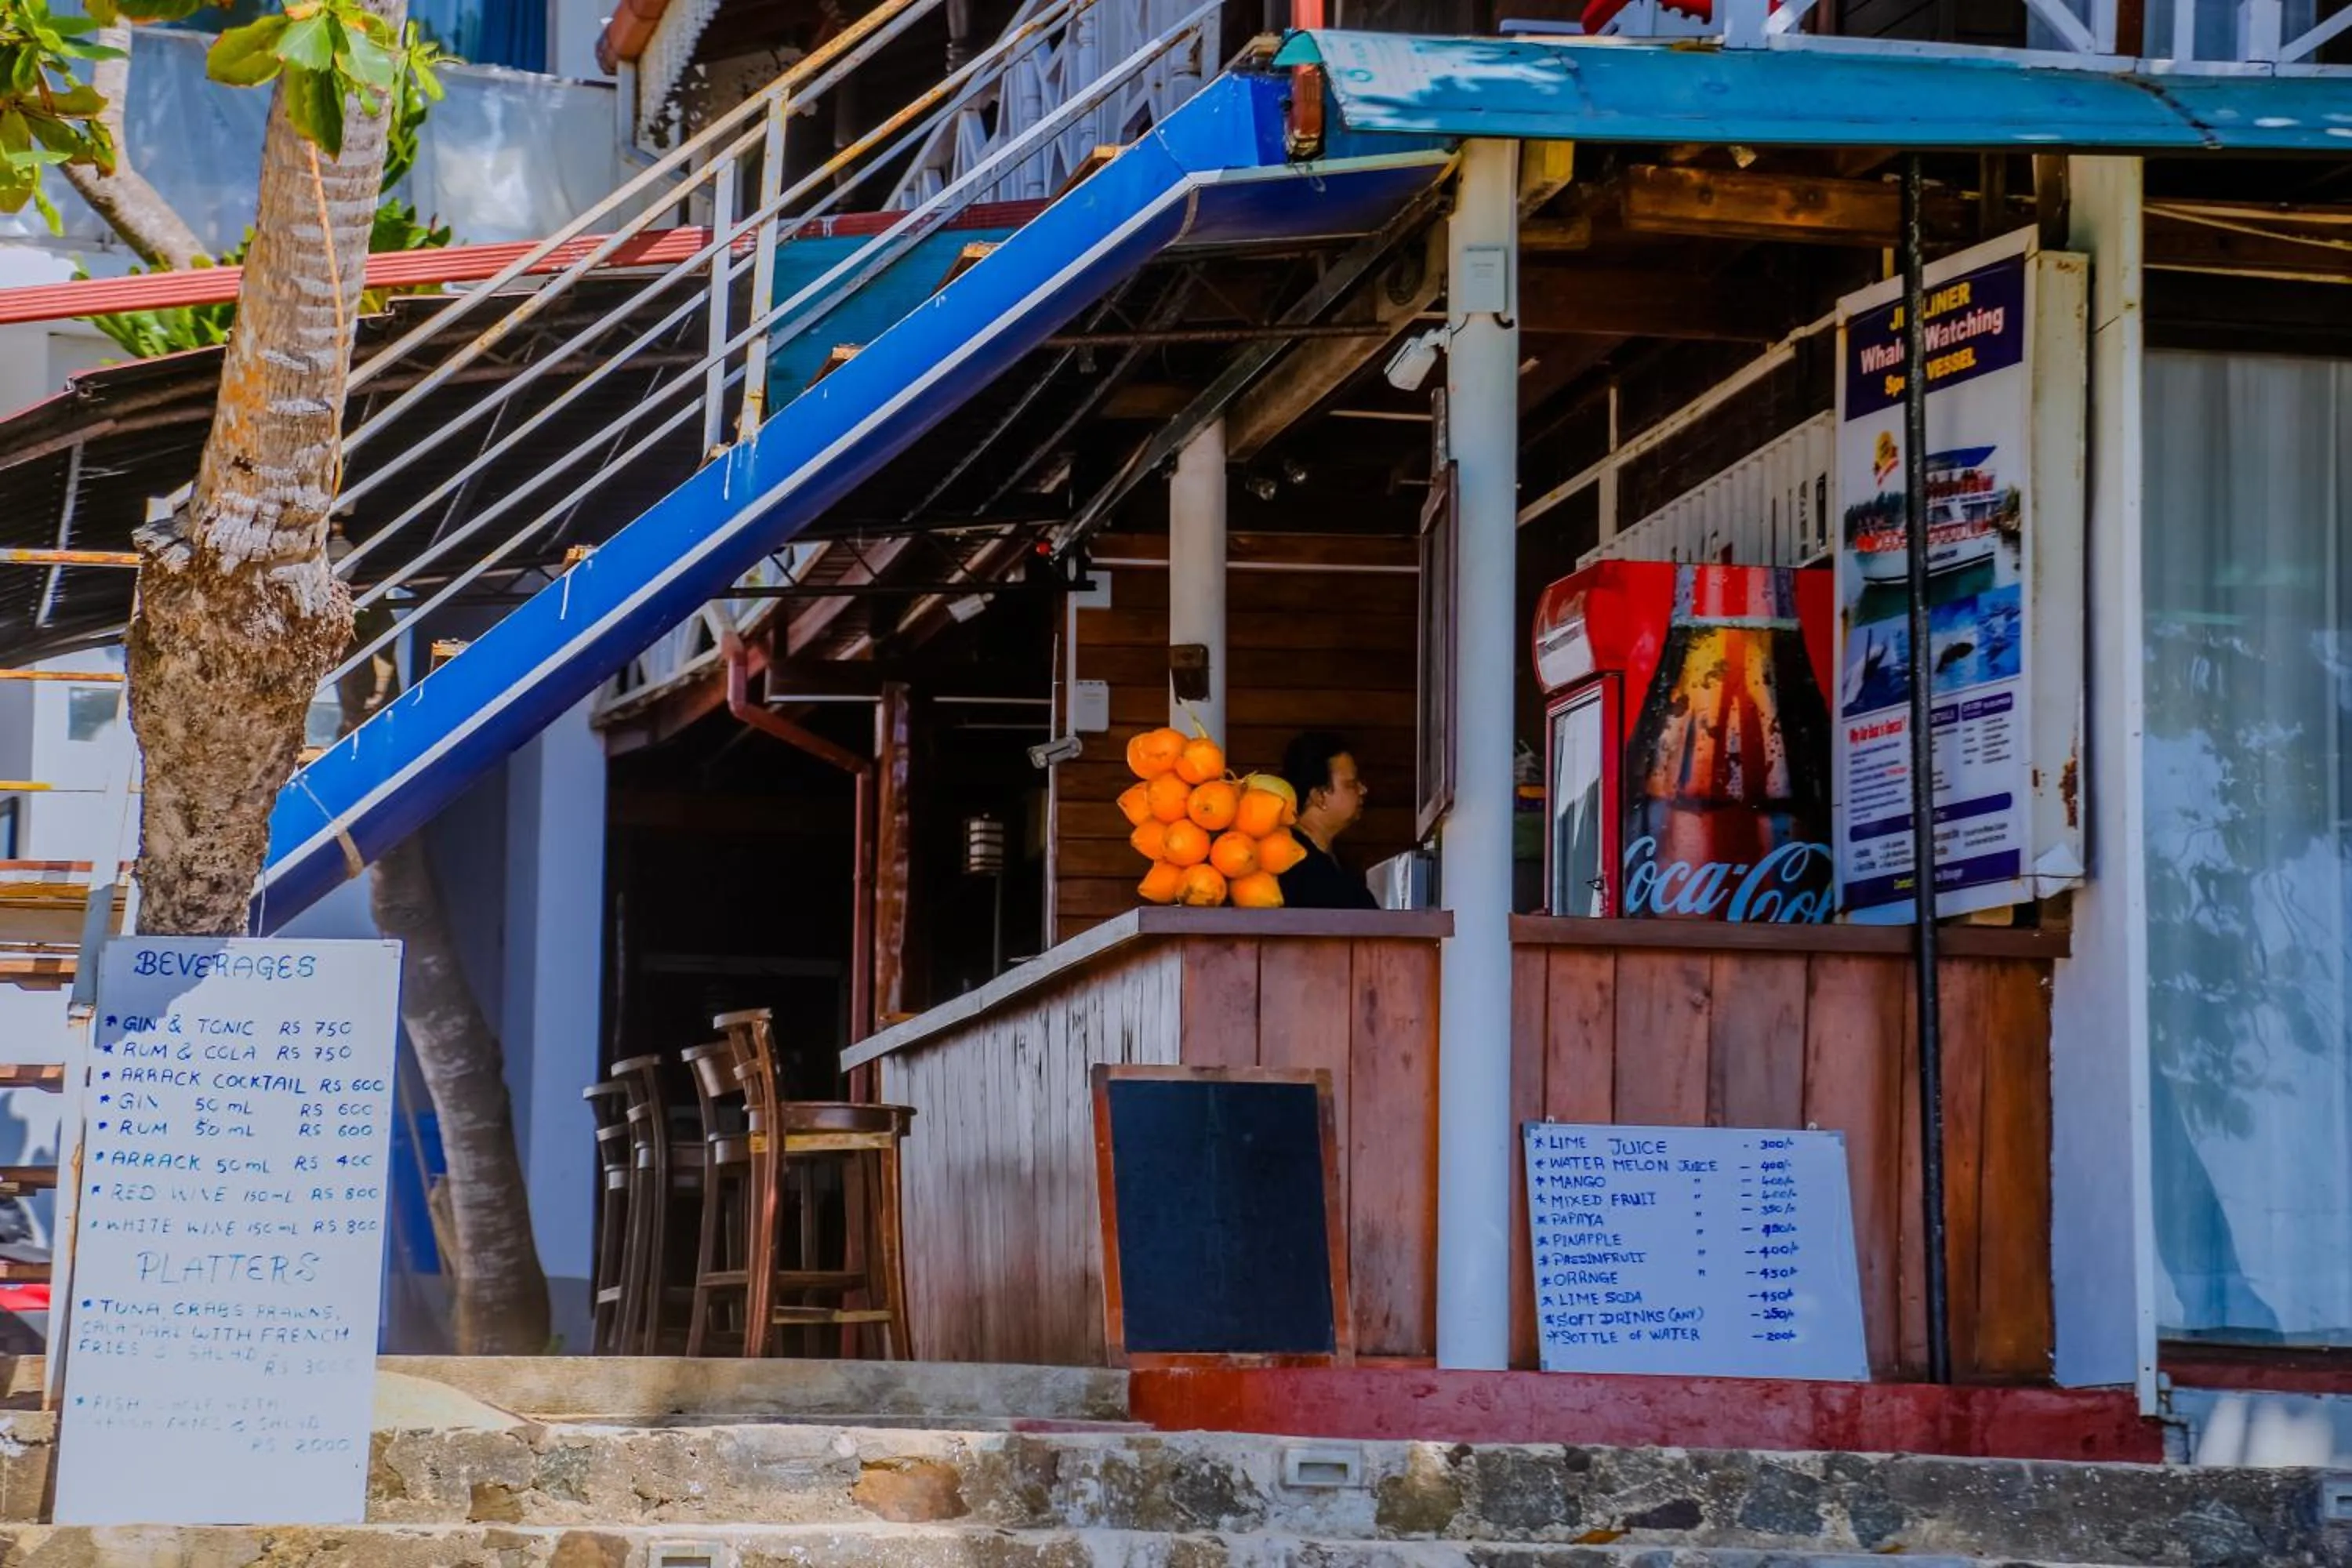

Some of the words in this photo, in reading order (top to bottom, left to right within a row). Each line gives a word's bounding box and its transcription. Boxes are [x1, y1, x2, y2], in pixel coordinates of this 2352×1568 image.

[1925, 307, 2005, 352] Watching
[1926, 347, 1976, 381] VESSEL
[134, 949, 316, 980] BEVERAGES
[123, 1015, 156, 1033] GIN
[168, 1014, 181, 1033] &
[198, 1019, 254, 1036] TONIC
[279, 1021, 300, 1035] RS
[315, 1022, 351, 1036] 750
[123, 1042, 167, 1058] RUM
[177, 1042, 192, 1060] &
[205, 1045, 256, 1060] COLA
[277, 1045, 300, 1060] RS
[314, 1045, 351, 1061] 750
[121, 1067, 201, 1086] ARRACK
[213, 1073, 307, 1094] COCKTAIL
[319, 1079, 341, 1093] RS
[352, 1080, 385, 1091] 600
[118, 1093, 158, 1110] GIN
[300, 1103, 323, 1116] RS
[338, 1103, 372, 1116] 600
[120, 1119, 168, 1135] RUM
[299, 1123, 322, 1137] RS
[338, 1124, 372, 1138] 600
[1550, 1137, 1588, 1149] LIME
[1607, 1138, 1668, 1155] JUICE
[111, 1151, 201, 1171] ARRACK
[294, 1156, 318, 1171] RS
[336, 1155, 372, 1167] 400
[1550, 1156, 1606, 1171] WATER
[1613, 1160, 1668, 1172] MELON
[1677, 1160, 1719, 1171] JUICE
[1551, 1175, 1606, 1189] MANGO
[112, 1183, 155, 1201] RED
[1551, 1194, 1602, 1209] MIXED
[1611, 1192, 1657, 1207] FRUIT
[1552, 1213, 1604, 1227] PAPAYA
[137, 1251, 321, 1285] PLATTERS
[1554, 1271, 1618, 1287] ORANGE
[1560, 1294, 1599, 1306] LIME
[1606, 1291, 1643, 1304] SODA
[1556, 1311, 1594, 1327] SOFT
[1599, 1310, 1666, 1325] DRINKS
[1649, 1327, 1700, 1341] WATER
